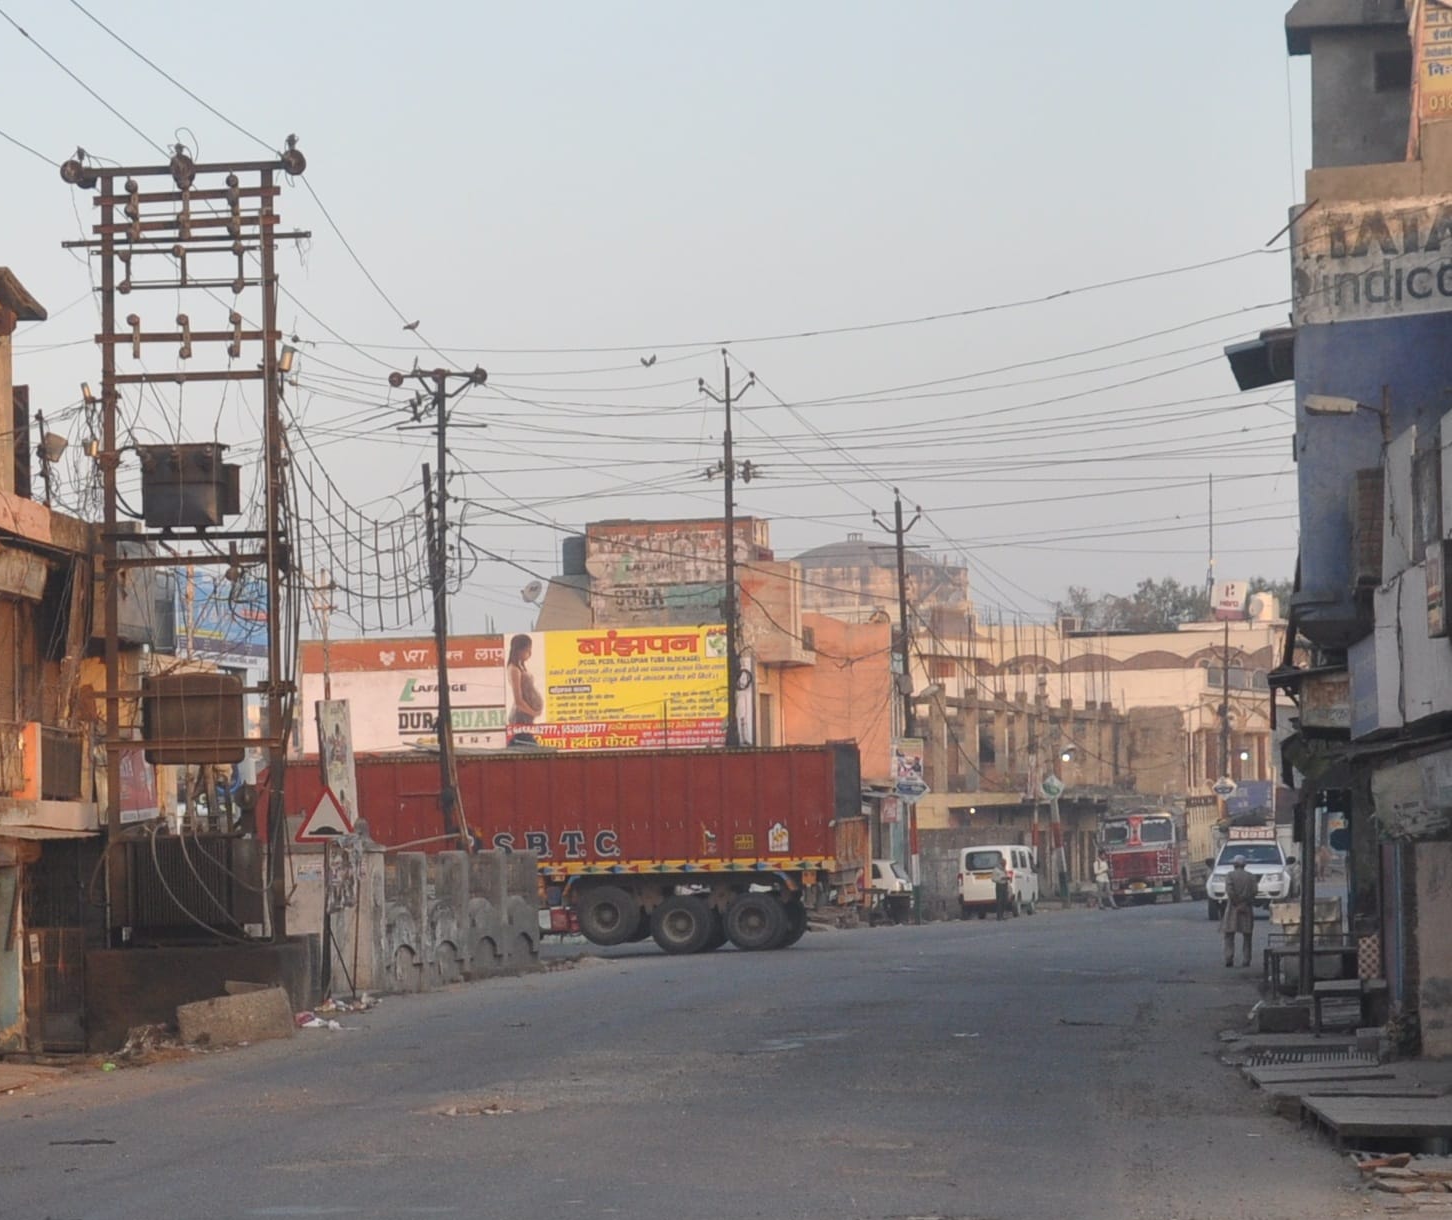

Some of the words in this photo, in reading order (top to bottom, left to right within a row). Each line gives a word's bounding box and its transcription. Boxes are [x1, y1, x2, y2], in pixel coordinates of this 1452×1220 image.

[577, 630, 700, 656] बांझपन
[412, 684, 467, 692] LAFGE
[399, 712, 438, 730] DUR
[606, 733, 638, 747] केयर
